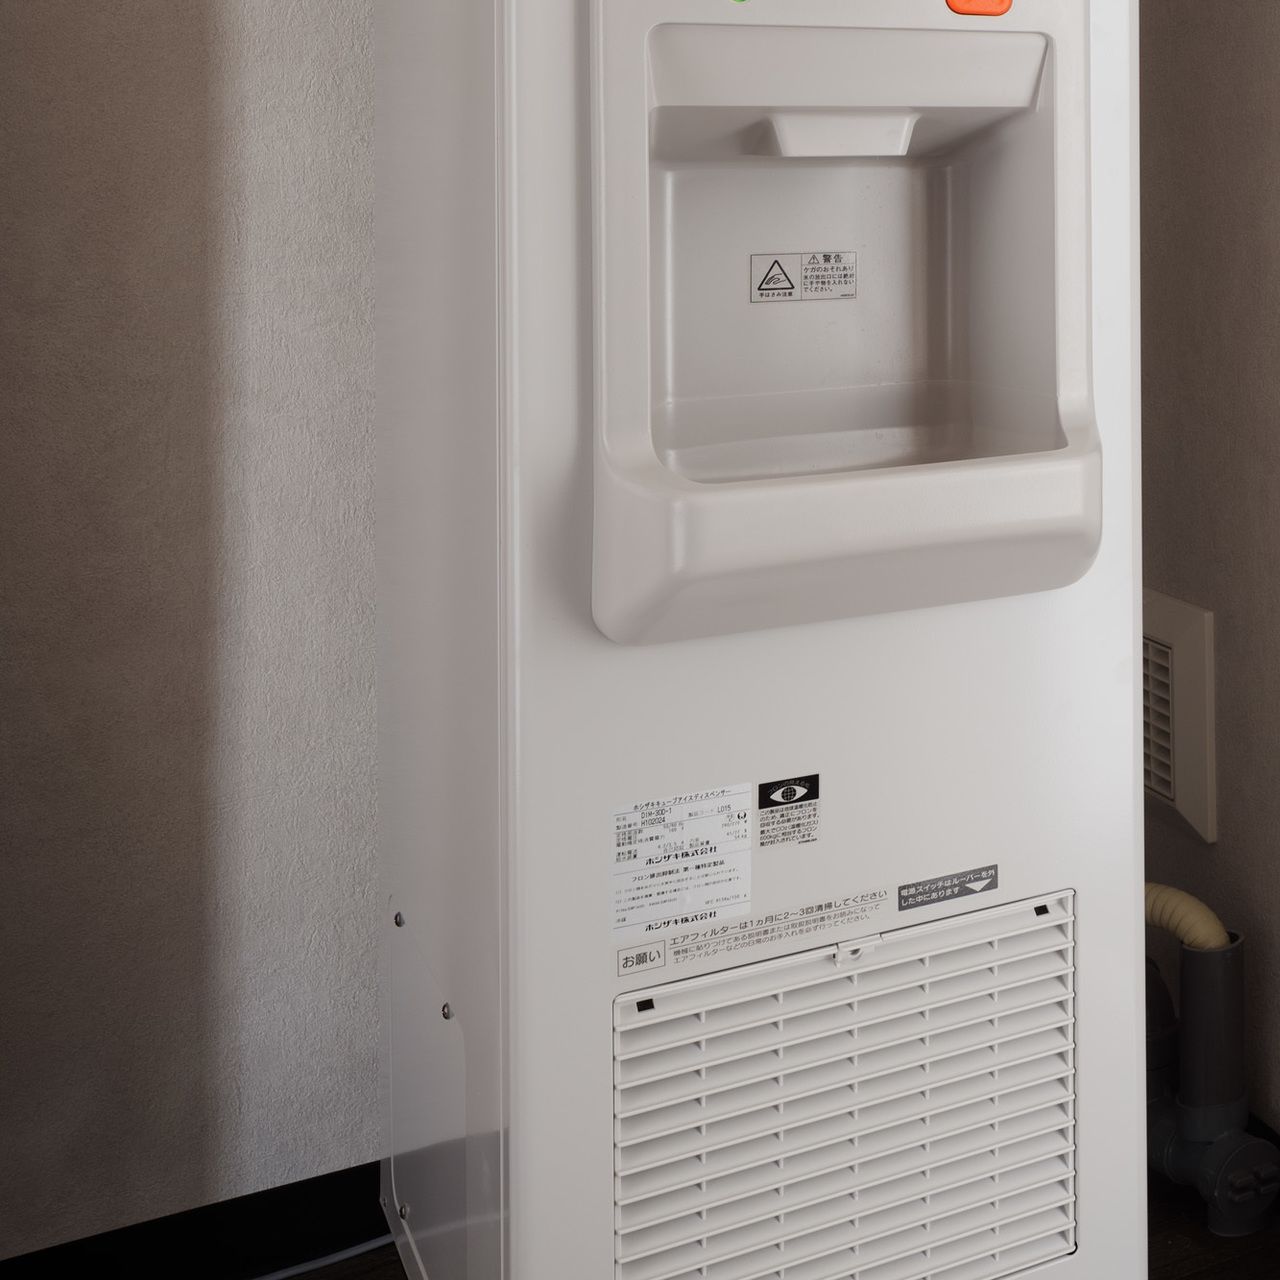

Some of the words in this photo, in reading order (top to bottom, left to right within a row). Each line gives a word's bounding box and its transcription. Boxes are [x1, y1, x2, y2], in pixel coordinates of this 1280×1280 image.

[803, 265, 854, 273] ケガのおそれあり
[645, 846, 717, 866] ホシザキ株式会社
[901, 887, 960, 906] した中にあります
[645, 910, 717, 932] ホシザキ株式会社
[622, 950, 661, 969] お願い
